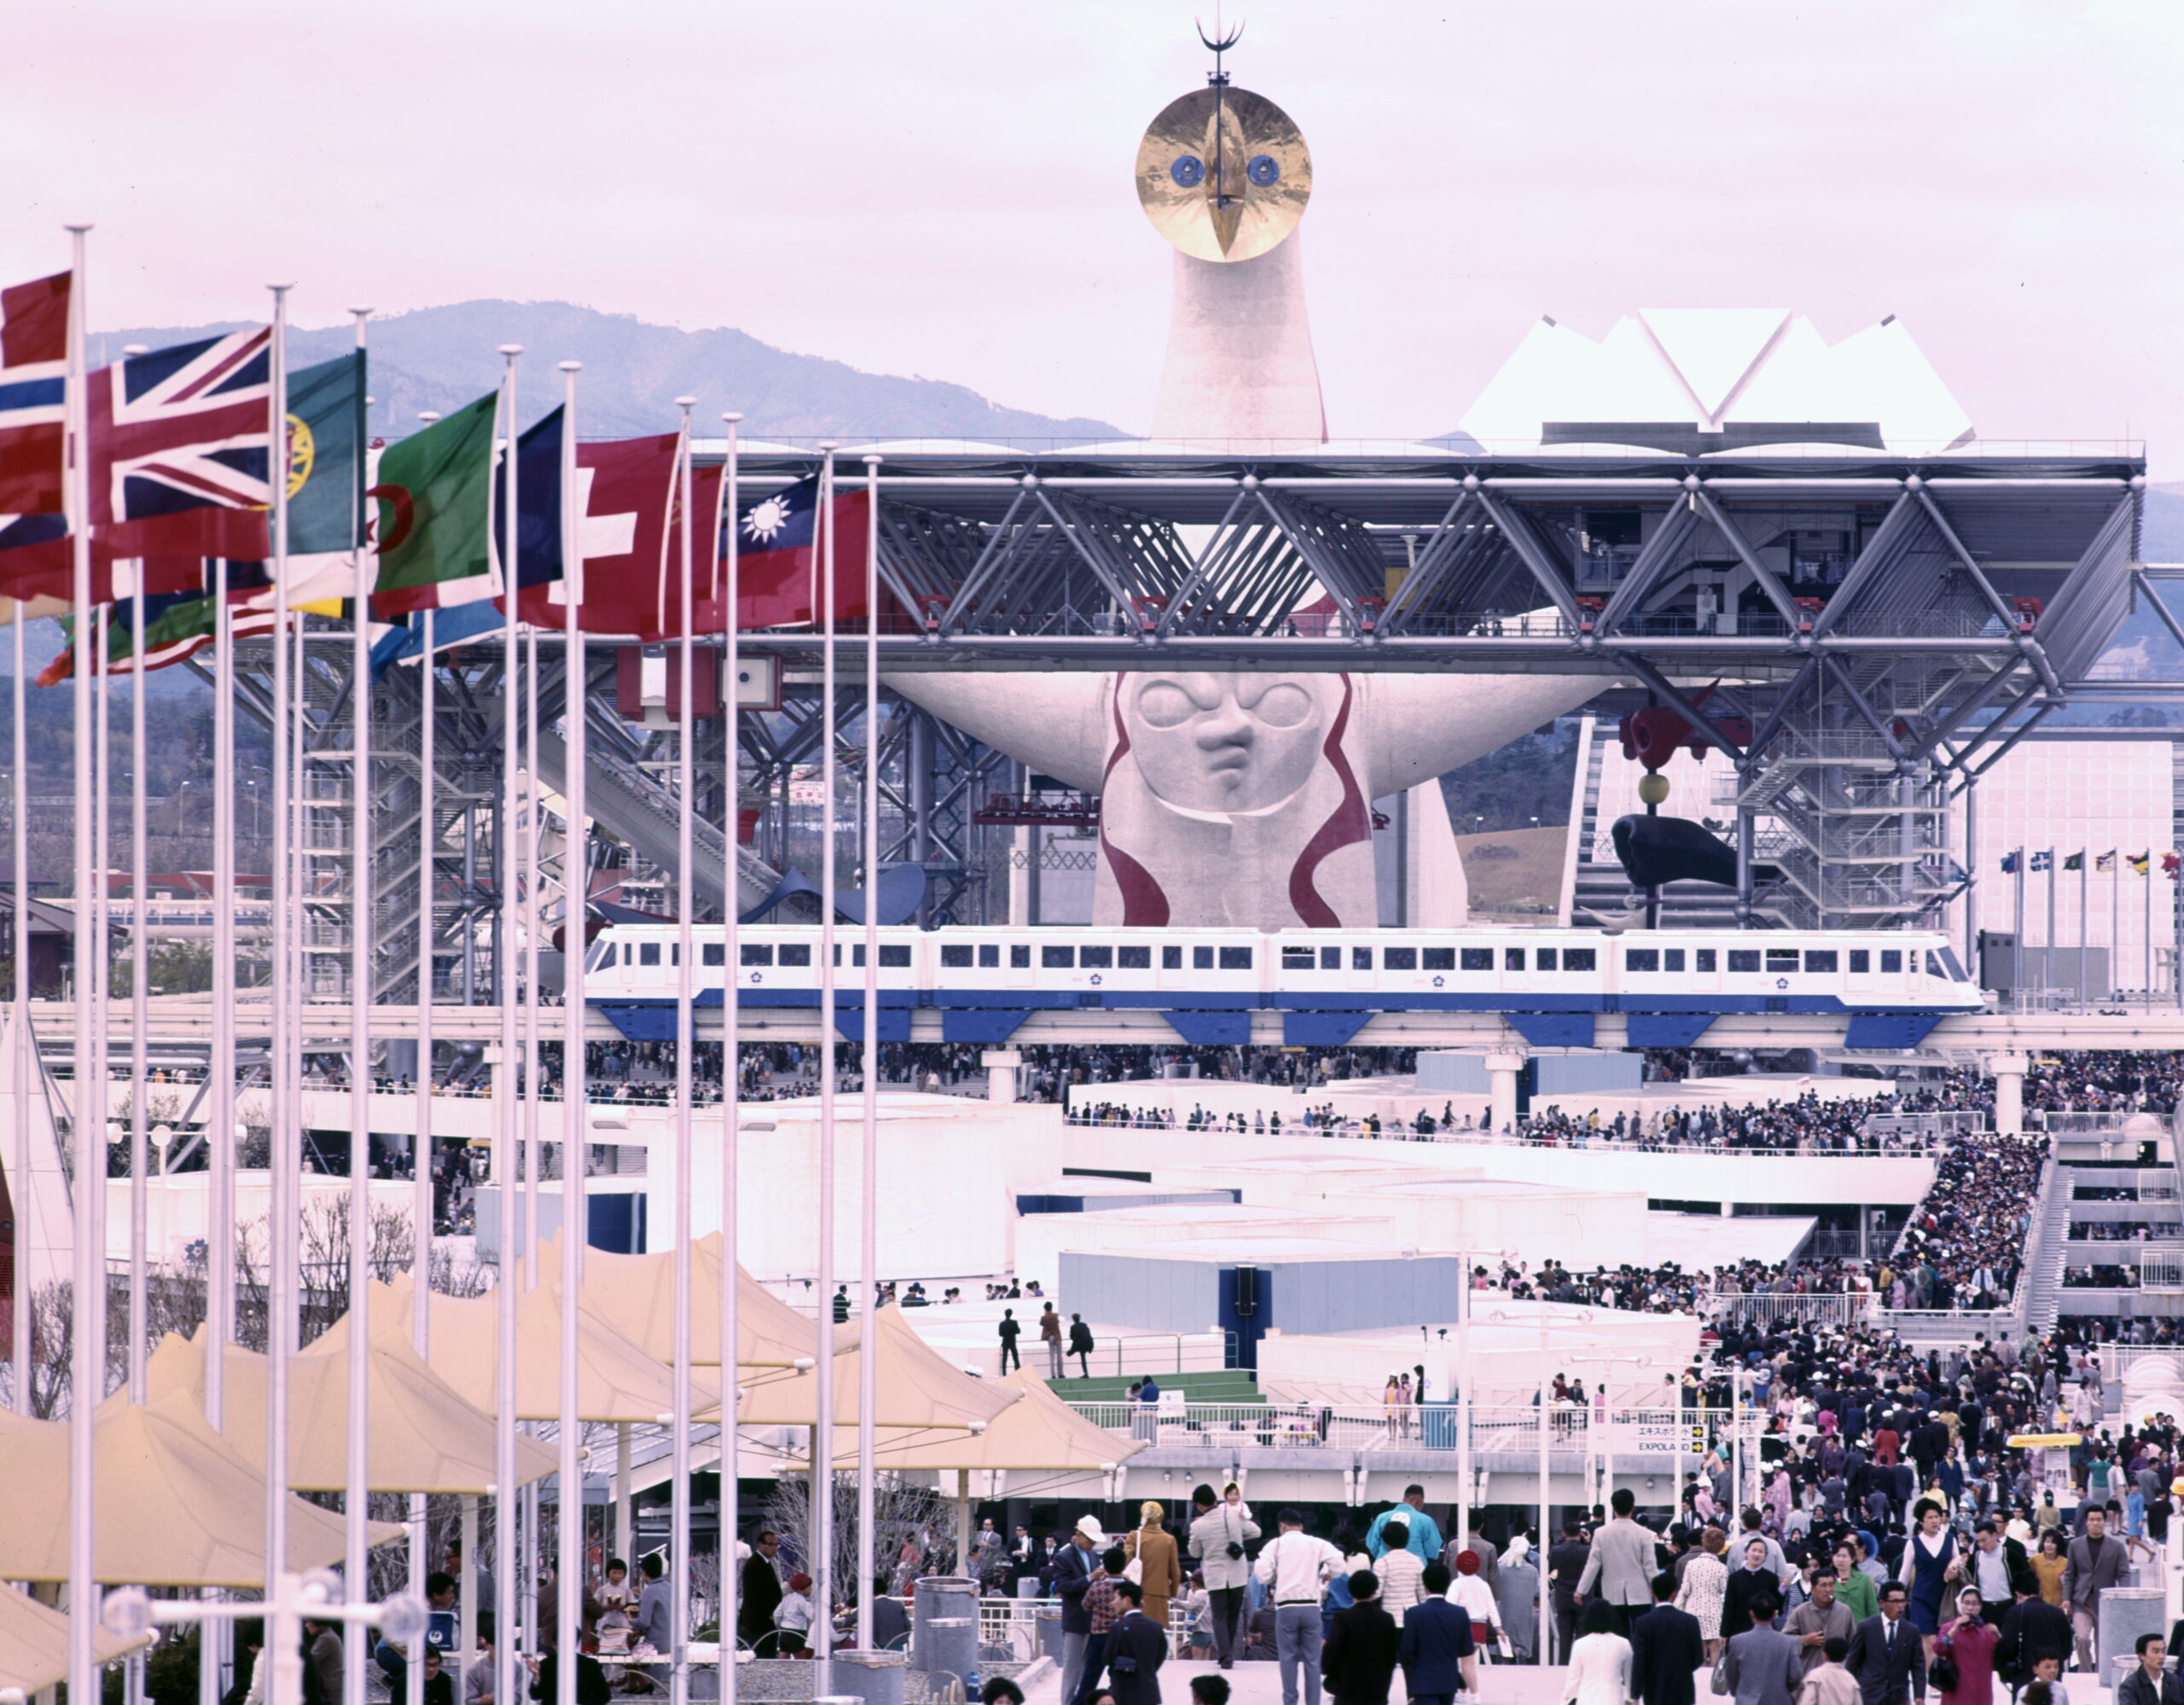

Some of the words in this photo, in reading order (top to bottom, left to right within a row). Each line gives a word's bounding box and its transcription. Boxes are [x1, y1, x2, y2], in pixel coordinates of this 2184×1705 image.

[1638, 1427, 1690, 1436] エキスポラド
[1638, 1442, 1690, 1451] EXPOLAD
